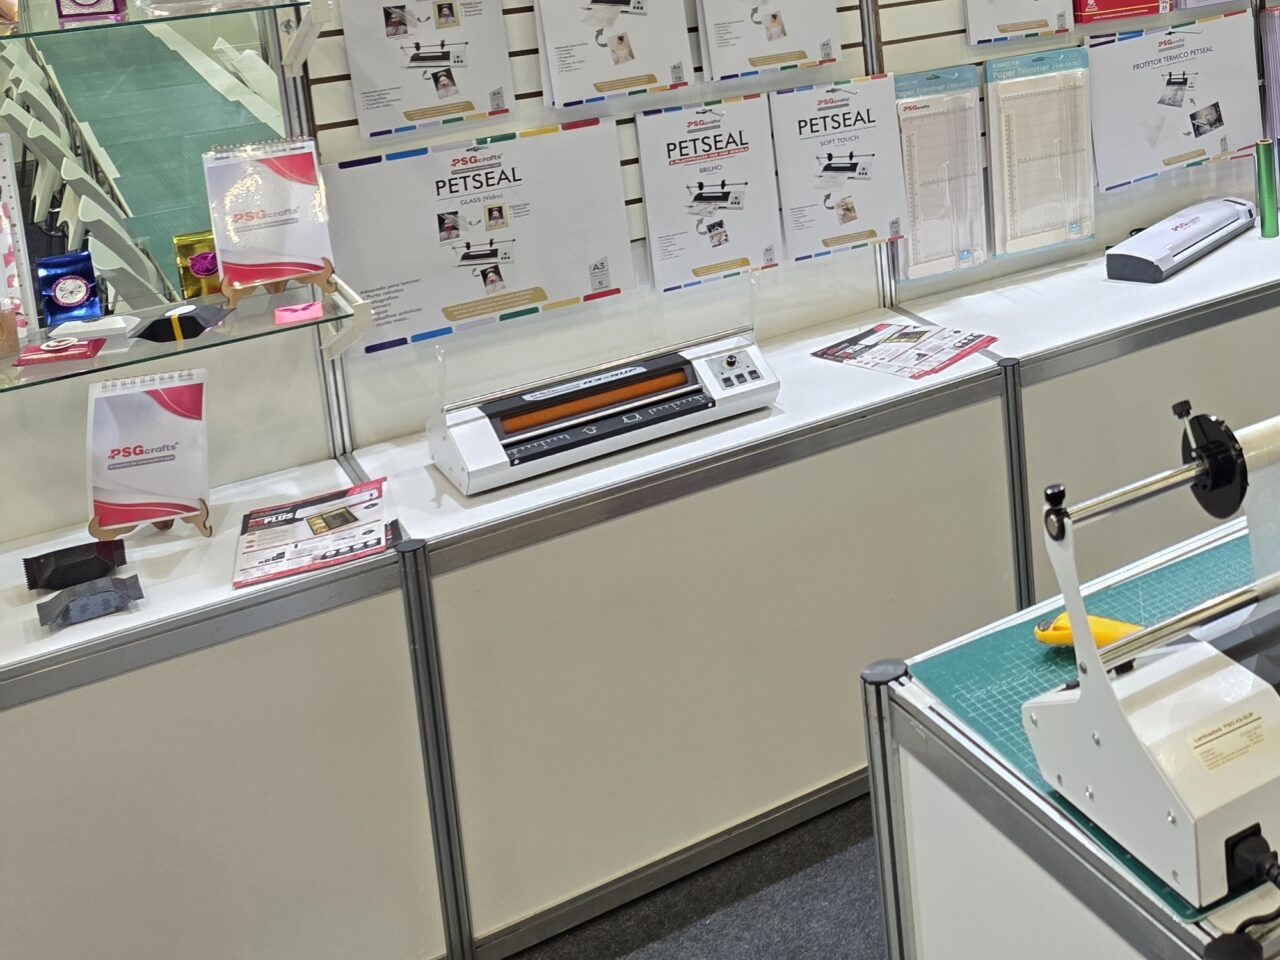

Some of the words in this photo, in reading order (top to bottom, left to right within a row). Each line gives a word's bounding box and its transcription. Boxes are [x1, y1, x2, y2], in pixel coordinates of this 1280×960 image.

[1133, 60, 1160, 70] PROTETOR
[1190, 46, 1213, 59] PETSEAL
[798, 109, 875, 135] PETSEAL
[666, 130, 748, 158] PETSEAL
[838, 135, 859, 144] TOUCH
[436, 167, 522, 196] PETSEAL
[460, 197, 481, 205] GLASS
[593, 262, 605, 271] A3
[108, 443, 179, 460] PSGcrafts
